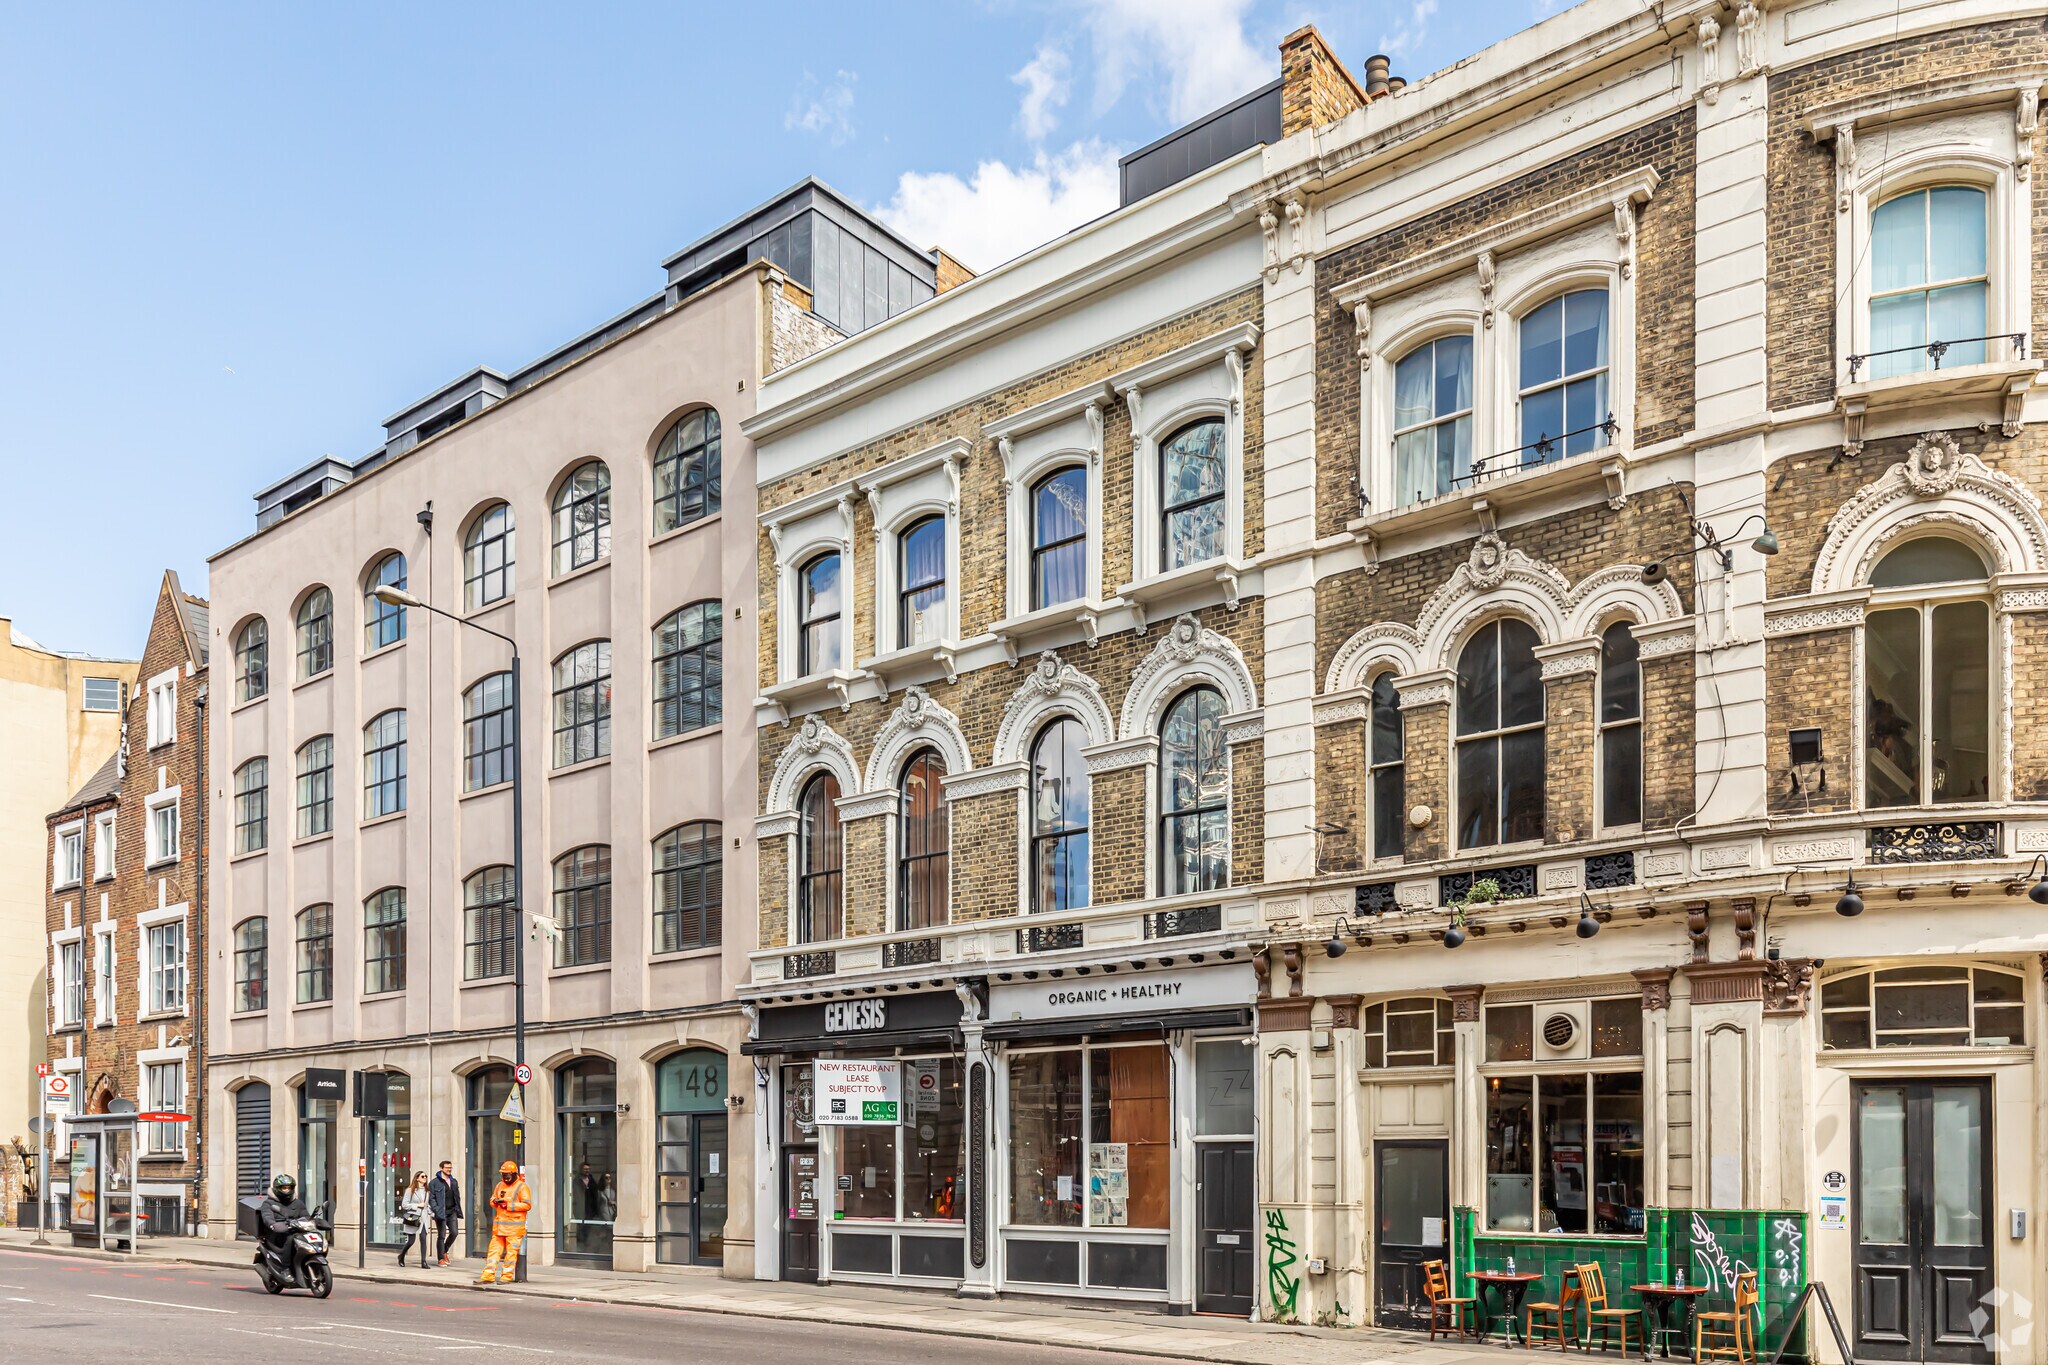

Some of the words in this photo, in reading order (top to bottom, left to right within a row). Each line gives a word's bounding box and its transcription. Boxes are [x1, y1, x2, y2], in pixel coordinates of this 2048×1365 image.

[1049, 989, 1107, 1005] ORGANIC
[1121, 983, 1182, 999] HEALTHY
[825, 999, 885, 1032] GENESIS
[518, 1069, 530, 1079] 20
[843, 1064, 895, 1072] RESTAURANT
[674, 1065, 719, 1098] 148
[829, 1085, 862, 1094] SUBJECT
